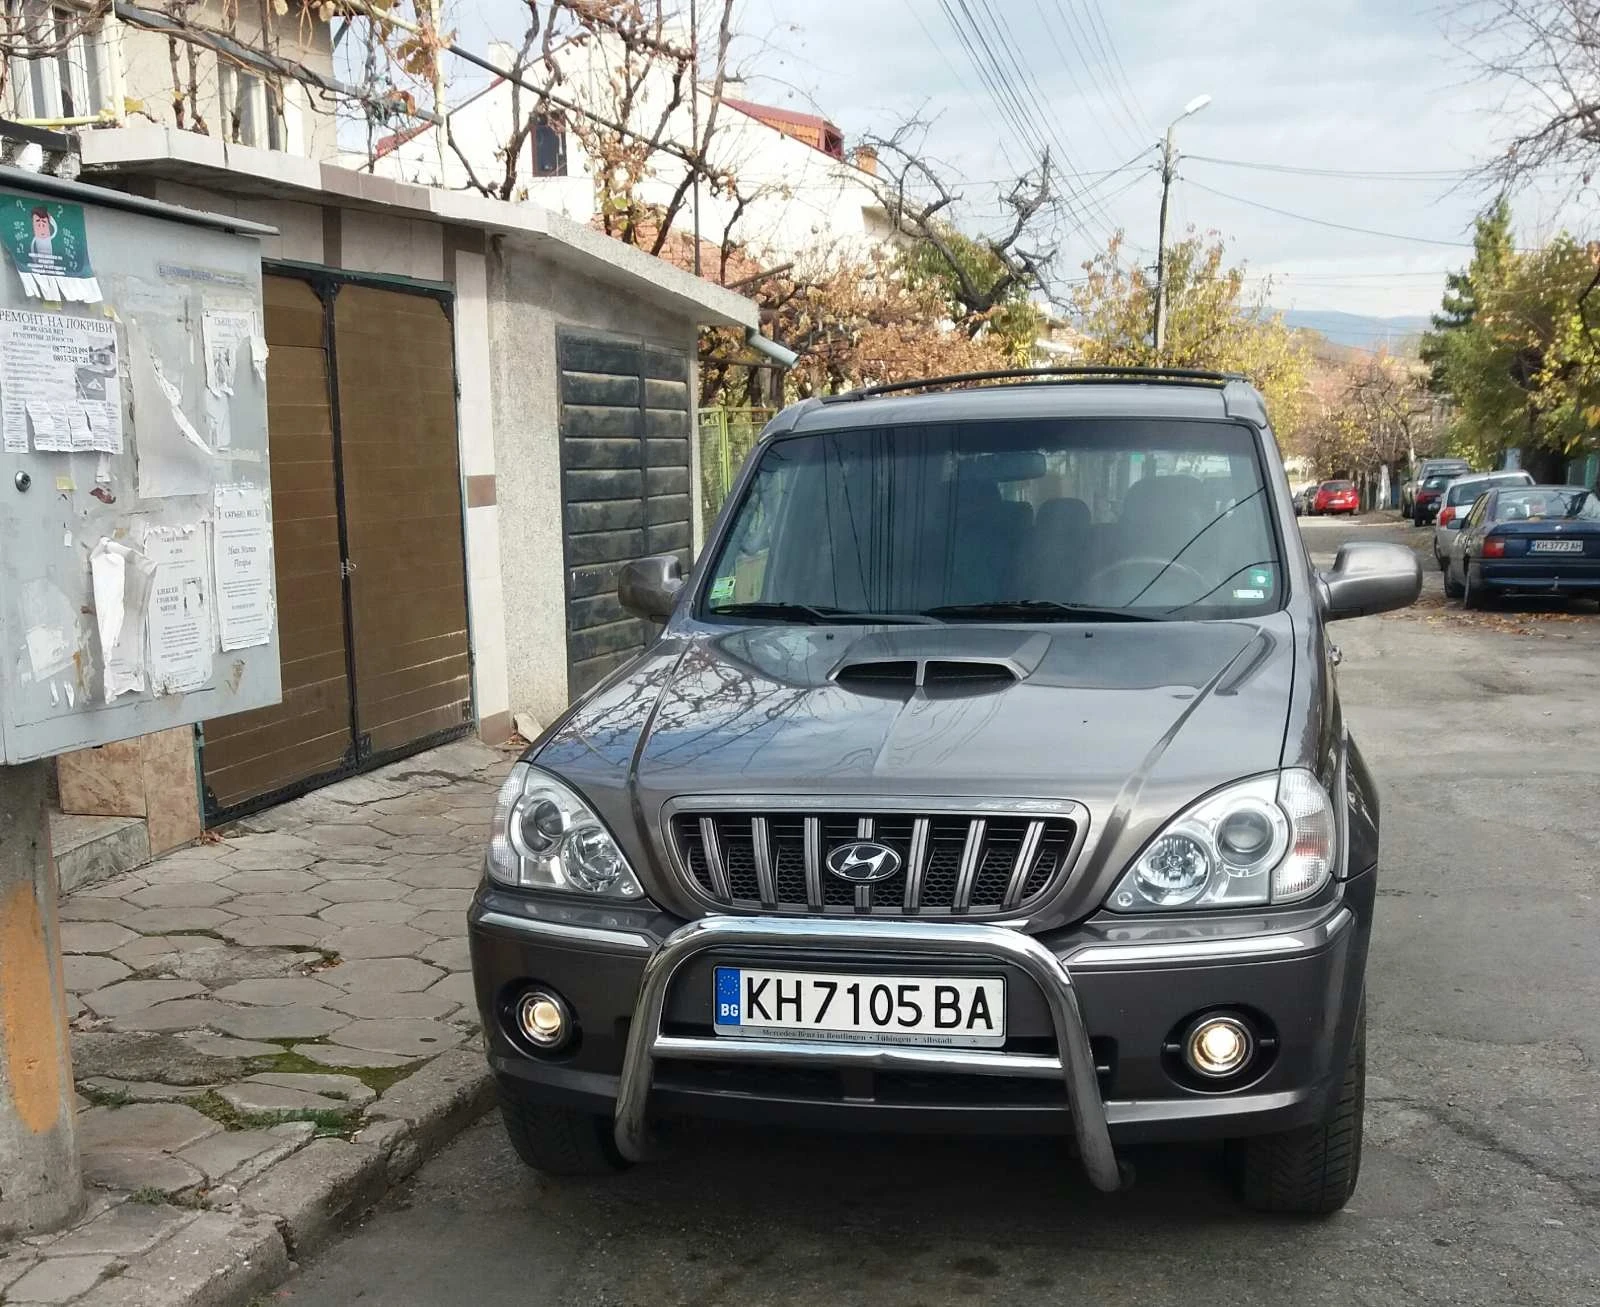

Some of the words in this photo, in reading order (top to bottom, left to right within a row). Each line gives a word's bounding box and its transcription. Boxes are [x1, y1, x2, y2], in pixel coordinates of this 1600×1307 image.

[0, 310, 44, 326] РЕМОНТ
[48, 315, 64, 329] НА
[66, 318, 113, 334] ПОКРИВИ
[720, 1003, 739, 1017] BG
[813, 981, 923, 1027] 7105
